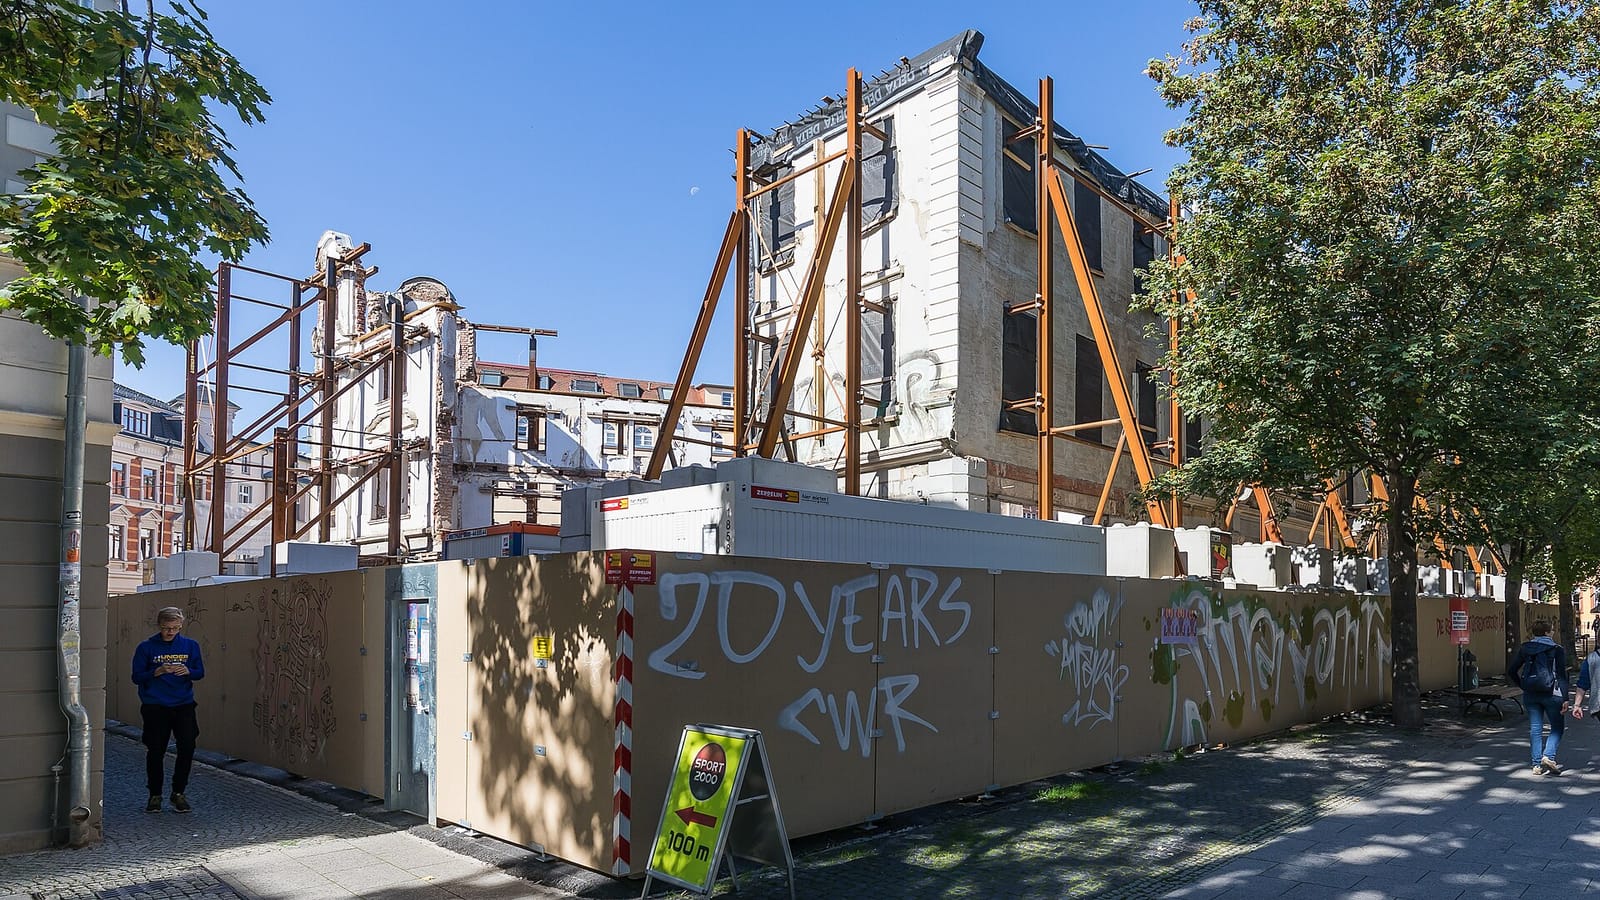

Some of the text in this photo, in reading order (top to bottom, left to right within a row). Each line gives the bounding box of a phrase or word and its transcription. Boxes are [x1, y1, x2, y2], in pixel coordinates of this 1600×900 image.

[796, 123, 820, 145] DELTA
[756, 489, 783, 499] ZEPPELIN
[648, 571, 786, 679] 20
[793, 567, 972, 673] YEARS
[694, 758, 725, 774] SPORT
[693, 770, 718, 785] 2000
[668, 830, 710, 862] 100 m
